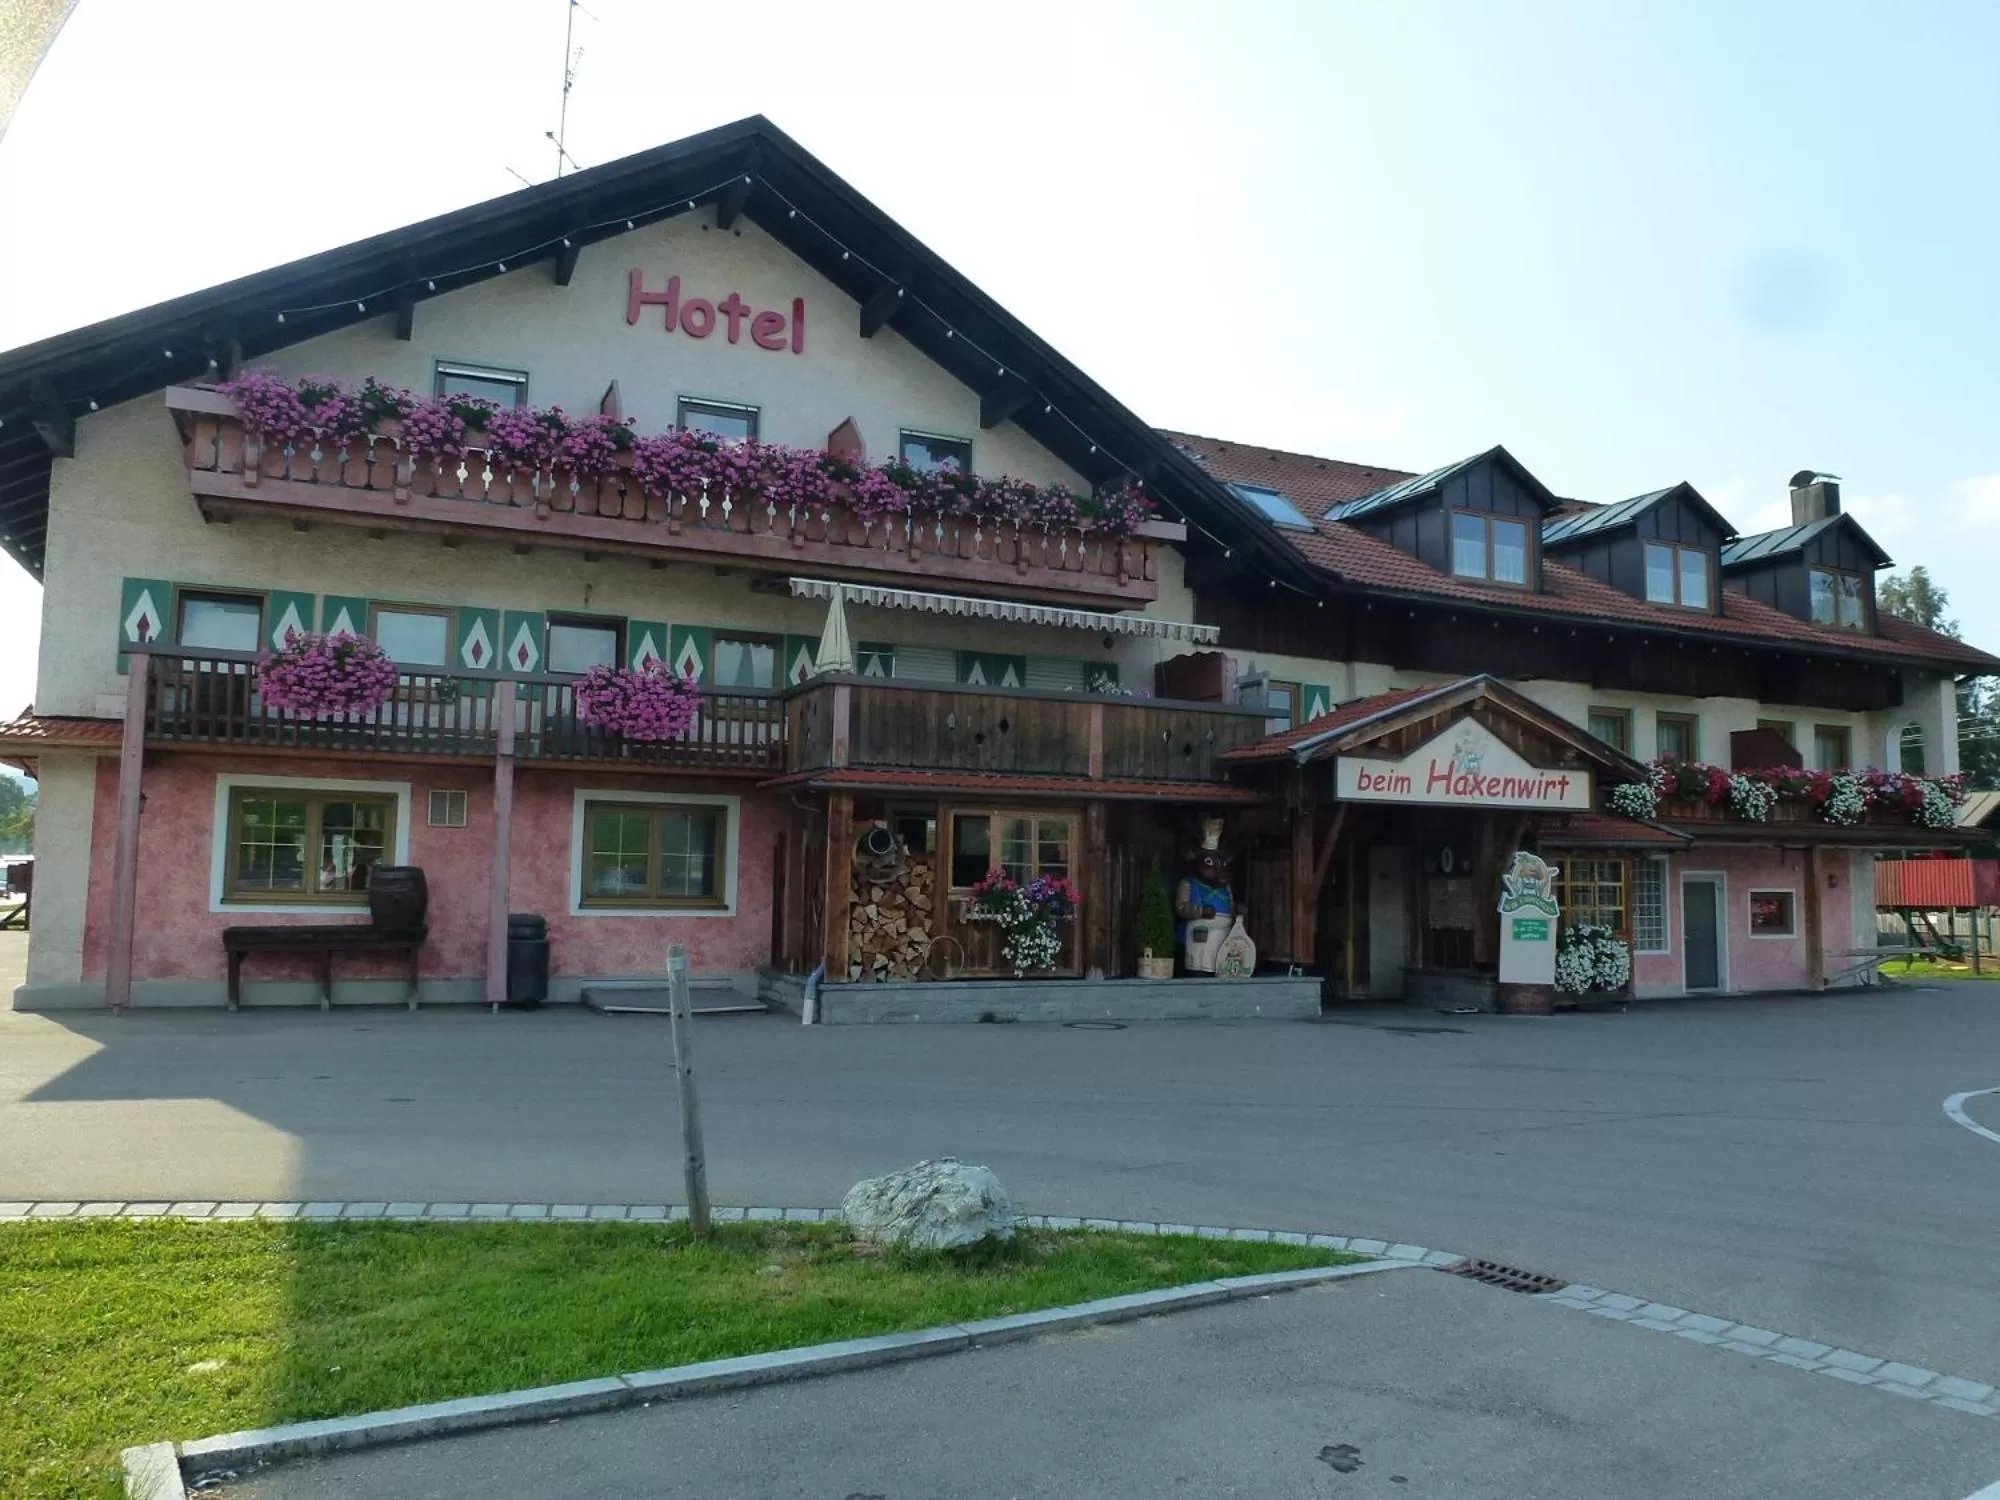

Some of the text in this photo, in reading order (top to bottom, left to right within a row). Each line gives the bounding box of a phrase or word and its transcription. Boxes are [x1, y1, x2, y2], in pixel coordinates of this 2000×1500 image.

[627, 267, 805, 355] Hotel
[1357, 758, 1570, 801] beim Haxenwirt
